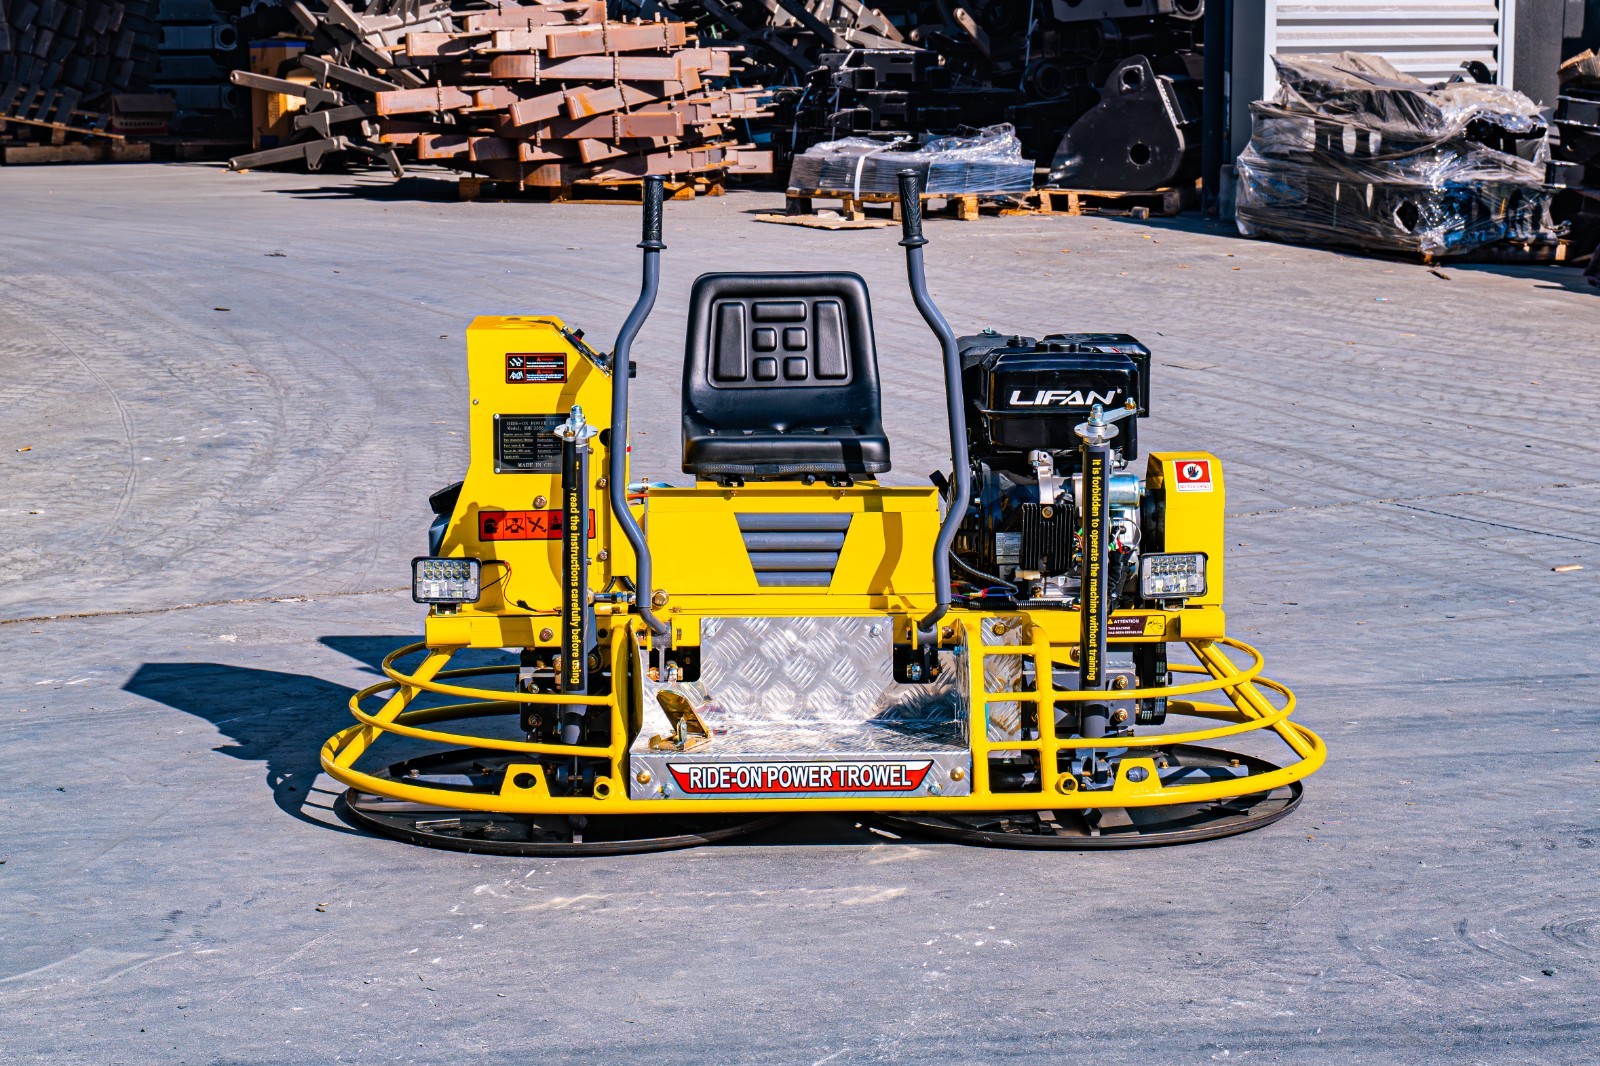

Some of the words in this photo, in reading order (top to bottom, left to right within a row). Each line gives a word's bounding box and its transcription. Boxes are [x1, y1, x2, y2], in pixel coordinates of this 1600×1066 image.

[1009, 390, 1116, 405] LIFAN
[1092, 467, 1101, 475] is
[570, 492, 580, 514] read
[1091, 477, 1101, 517] forbidden
[570, 516, 580, 531] the
[1091, 518, 1100, 528] to
[570, 533, 581, 587] instructions
[1089, 530, 1100, 562] operate
[1090, 563, 1100, 577] the
[570, 588, 581, 626] carefully
[1089, 578, 1100, 613] machine
[571, 628, 581, 658] before
[1089, 615, 1099, 647] without
[570, 659, 581, 684] using
[1086, 649, 1098, 681] training
[688, 767, 763, 790] RIDE-ON
[766, 765, 834, 789] POWER
[836, 764, 913, 788] TROWEL
